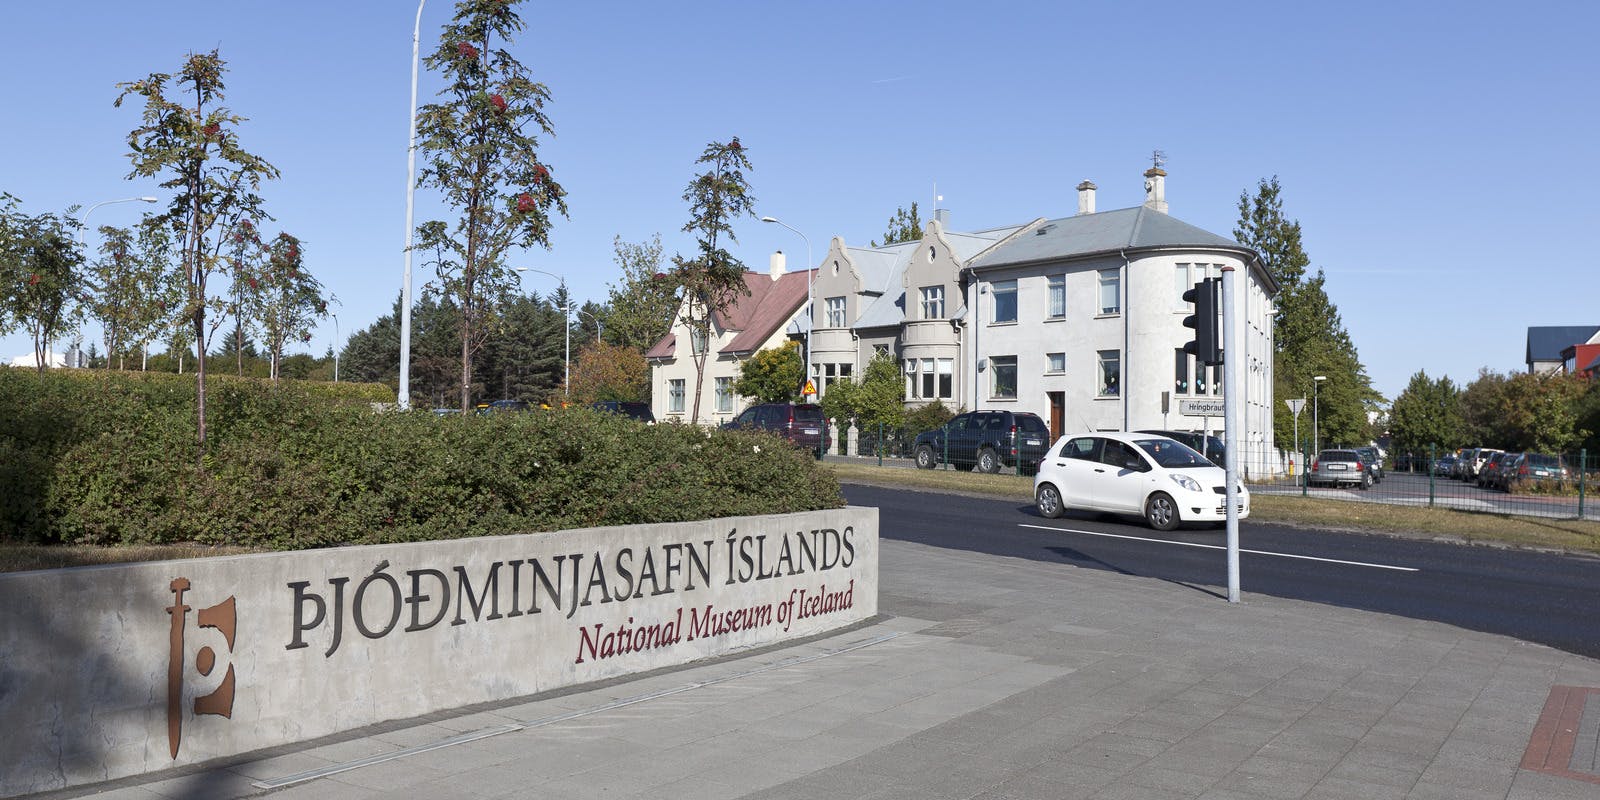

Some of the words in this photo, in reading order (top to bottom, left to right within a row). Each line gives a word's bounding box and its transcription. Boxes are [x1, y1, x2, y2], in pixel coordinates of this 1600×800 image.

[1188, 403, 1225, 412] Hringbraut
[285, 539, 714, 658] ÞJÓÐMINJASAFN
[725, 526, 855, 585] ÍSLANDS
[575, 608, 682, 664] National
[687, 604, 773, 641] Museum
[776, 588, 798, 632] of
[797, 579, 854, 620] Iceland
